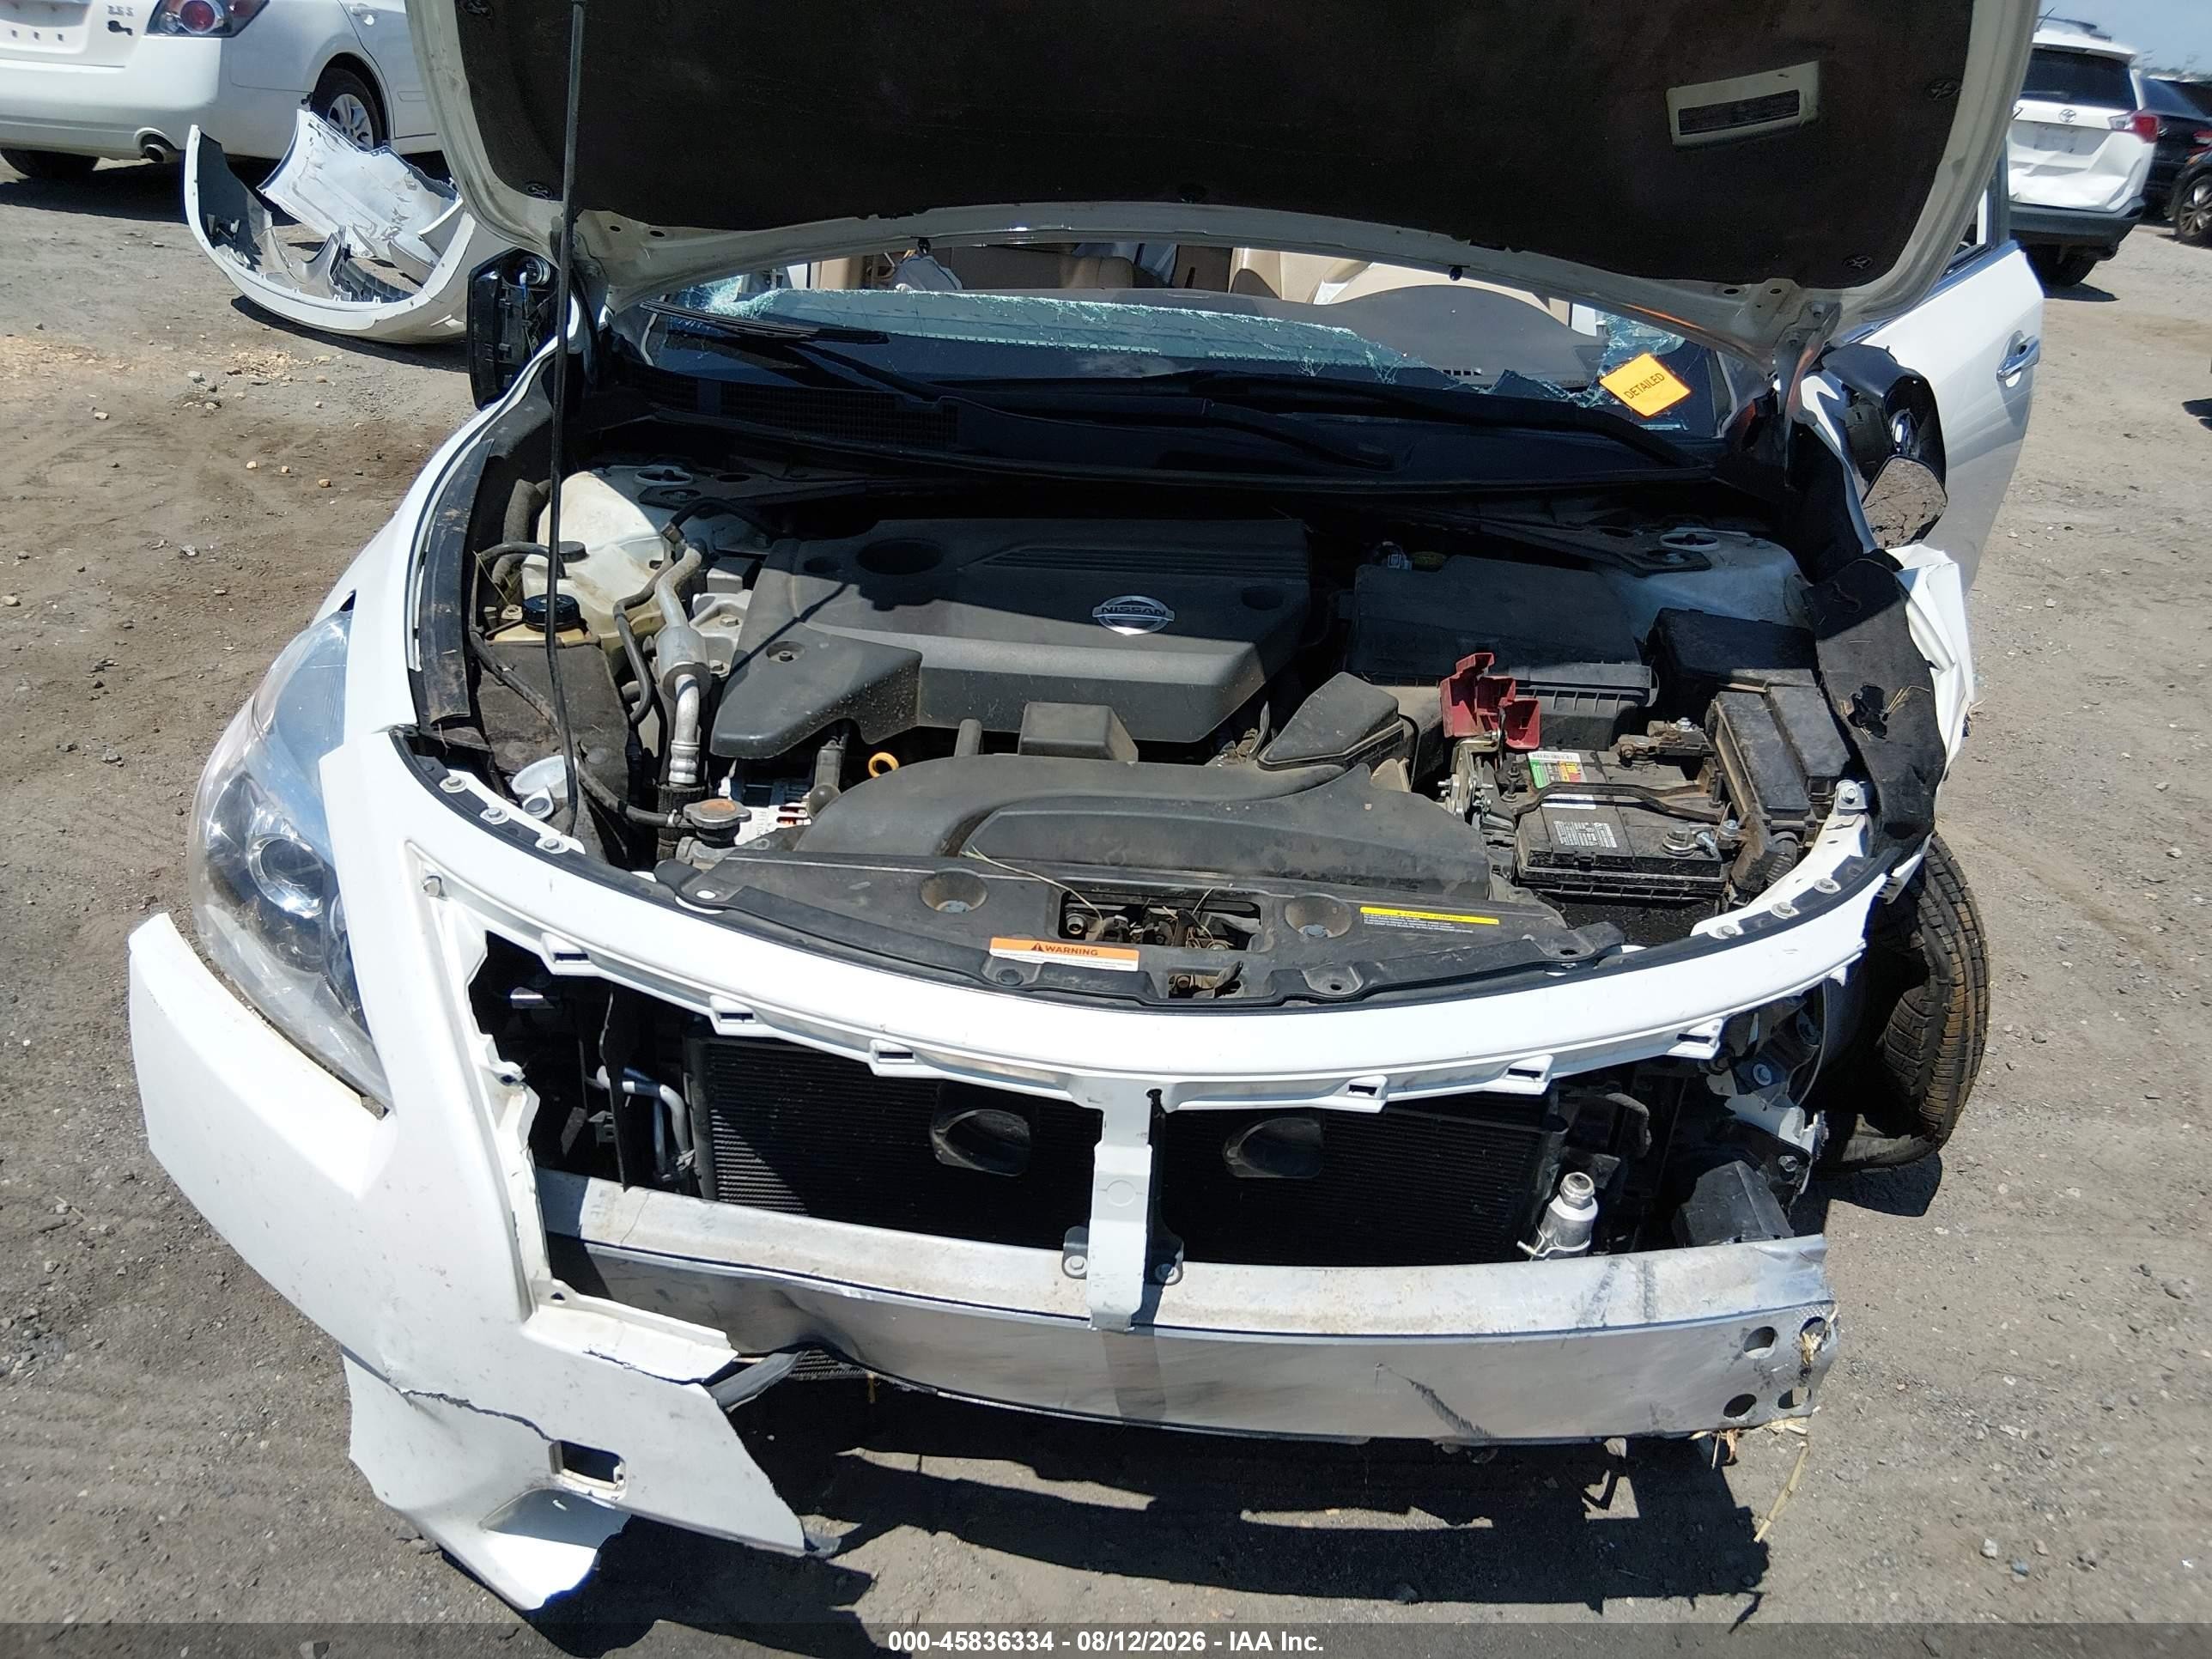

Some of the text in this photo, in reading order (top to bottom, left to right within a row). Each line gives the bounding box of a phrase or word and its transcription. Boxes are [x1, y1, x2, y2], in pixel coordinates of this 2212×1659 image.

[1624, 373, 1665, 399] DETAILED
[1101, 606, 1166, 616] NISSAN
[1045, 945, 1098, 957] WARNING
